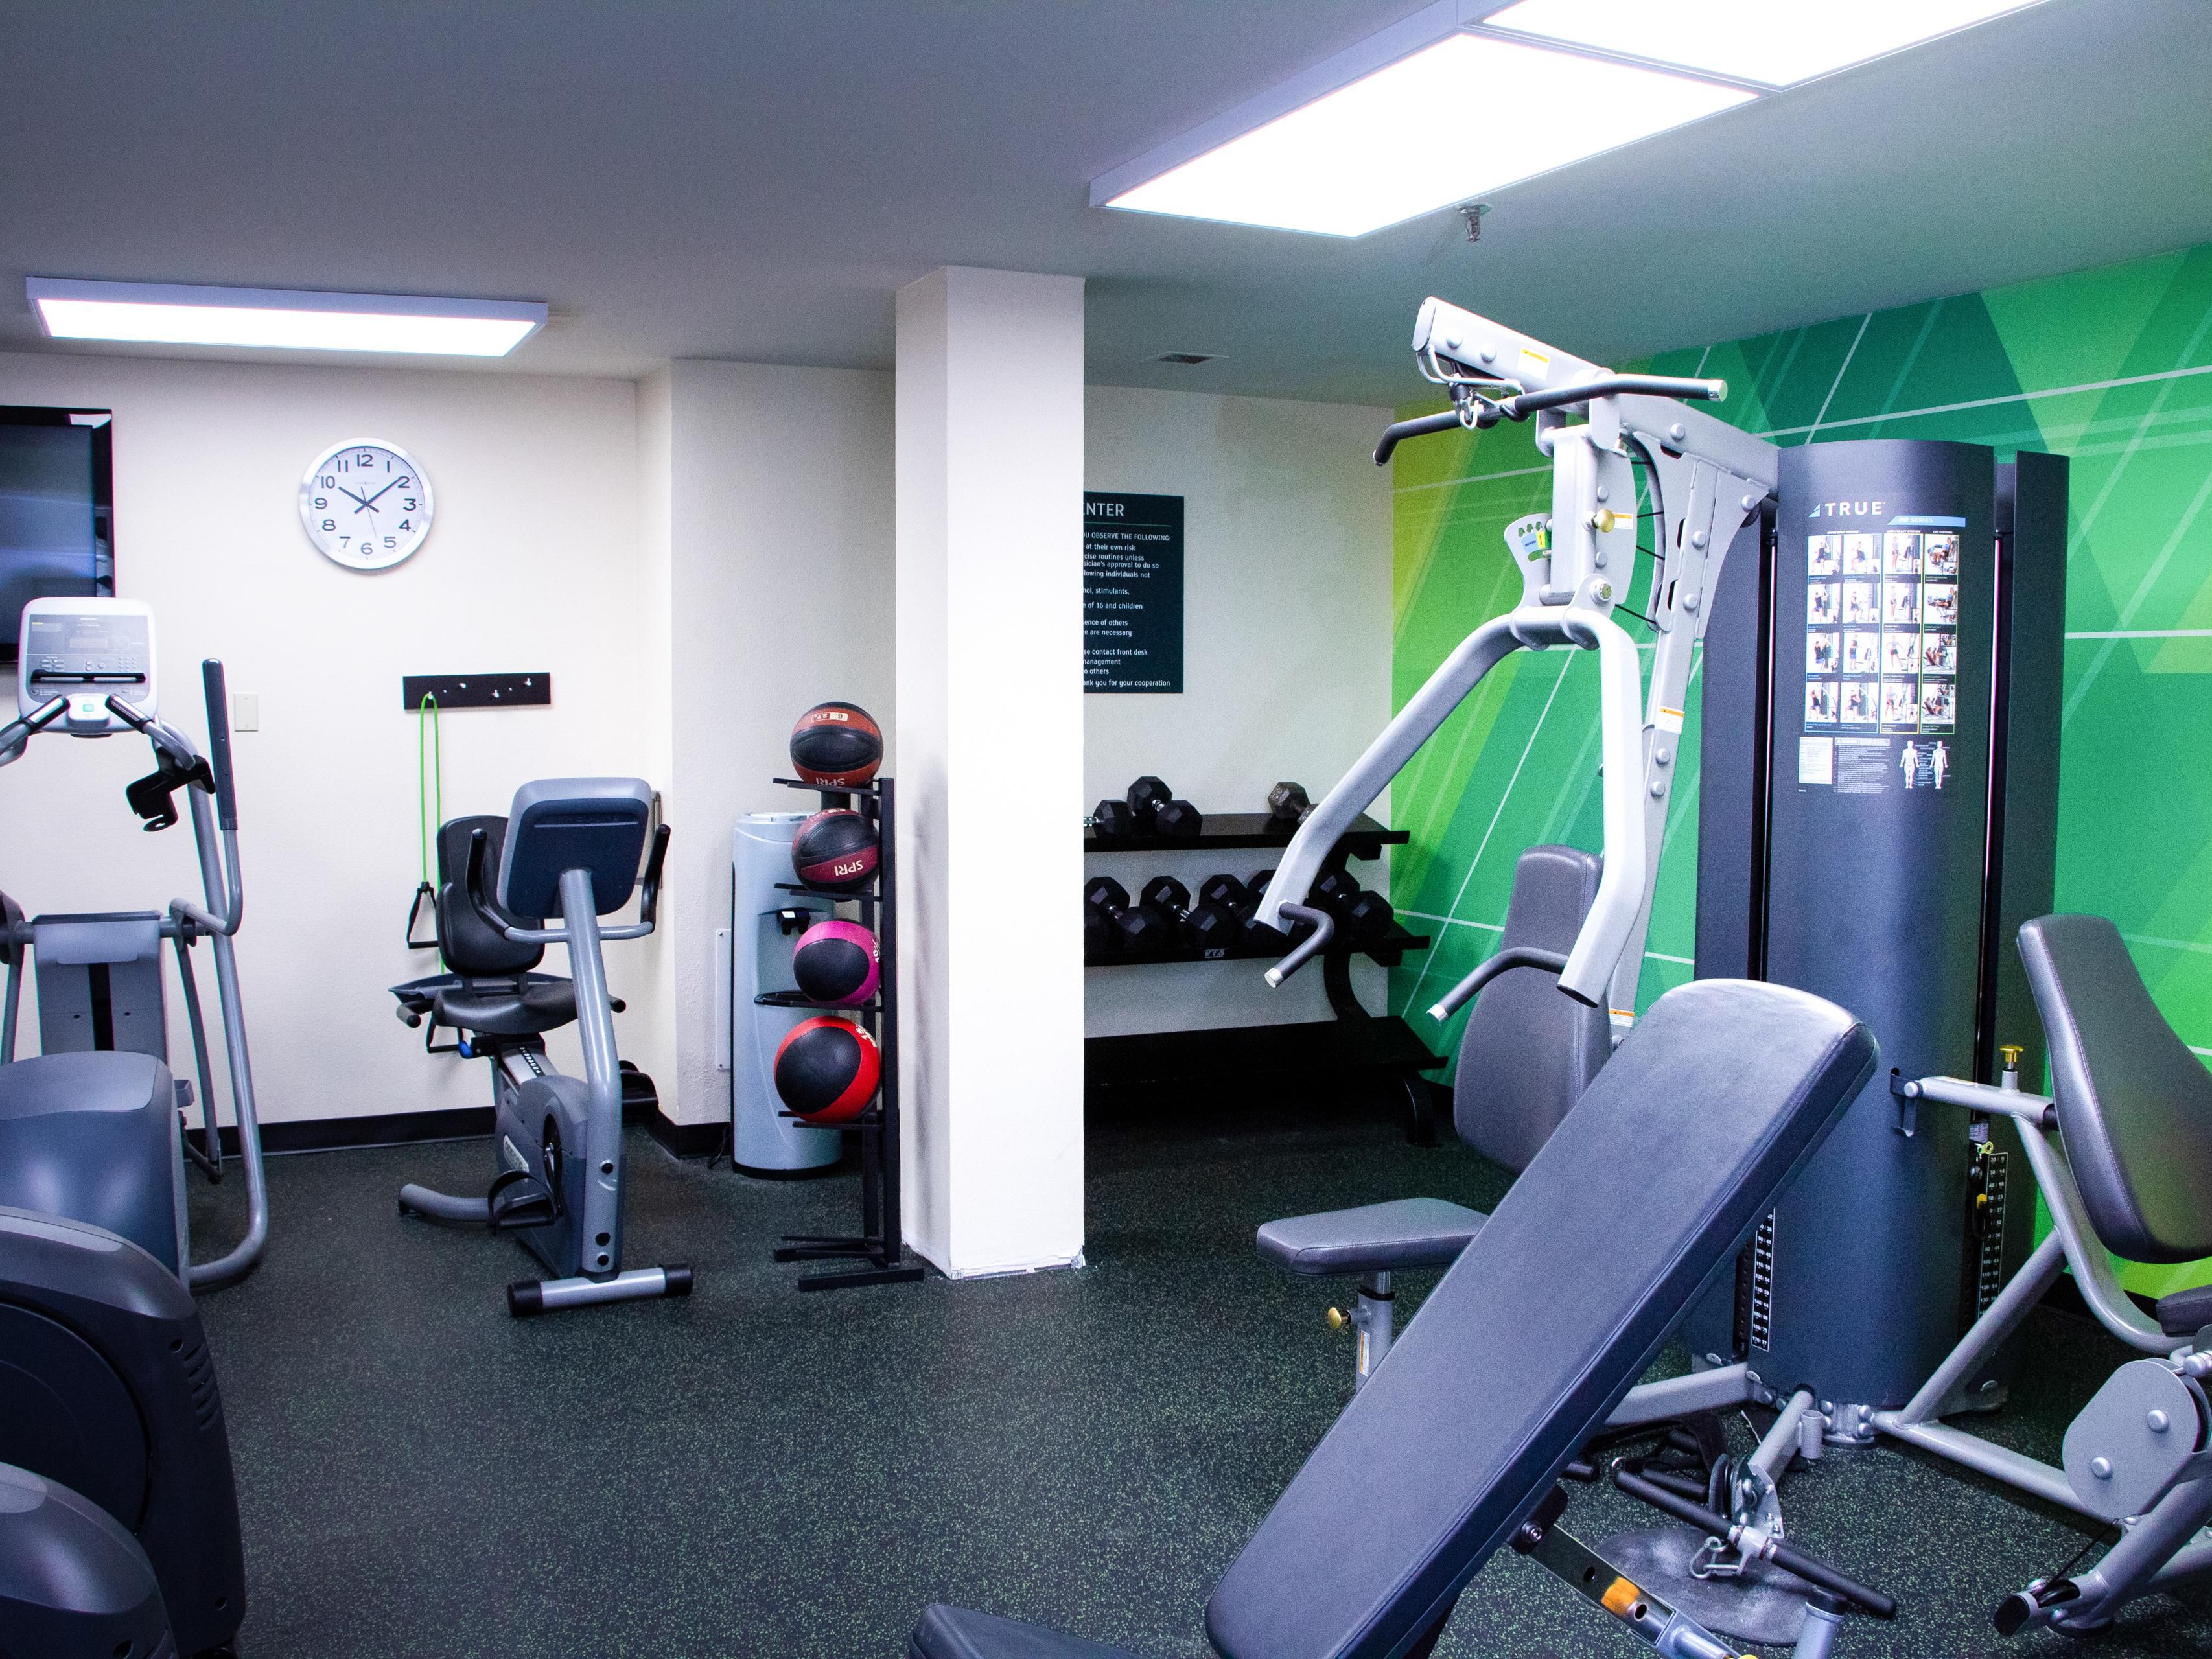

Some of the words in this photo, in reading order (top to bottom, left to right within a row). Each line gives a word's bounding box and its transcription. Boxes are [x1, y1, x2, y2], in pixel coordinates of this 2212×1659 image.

[338, 460, 349, 472] 11
[357, 454, 373, 467] 12
[387, 461, 390, 473] 1
[321, 476, 335, 489] 10
[397, 476, 410, 488] 2
[314, 498, 327, 509] 9
[403, 498, 417, 511] 3
[1084, 502, 1124, 517] NTER
[1825, 501, 1882, 516] TRUE
[322, 519, 336, 531] 8
[399, 519, 411, 531] 4
[339, 536, 351, 548] 7
[384, 537, 397, 548] 5
[360, 542, 373, 555] 6
[816, 777, 844, 787] SPRI
[834, 860, 863, 876] SPRI
